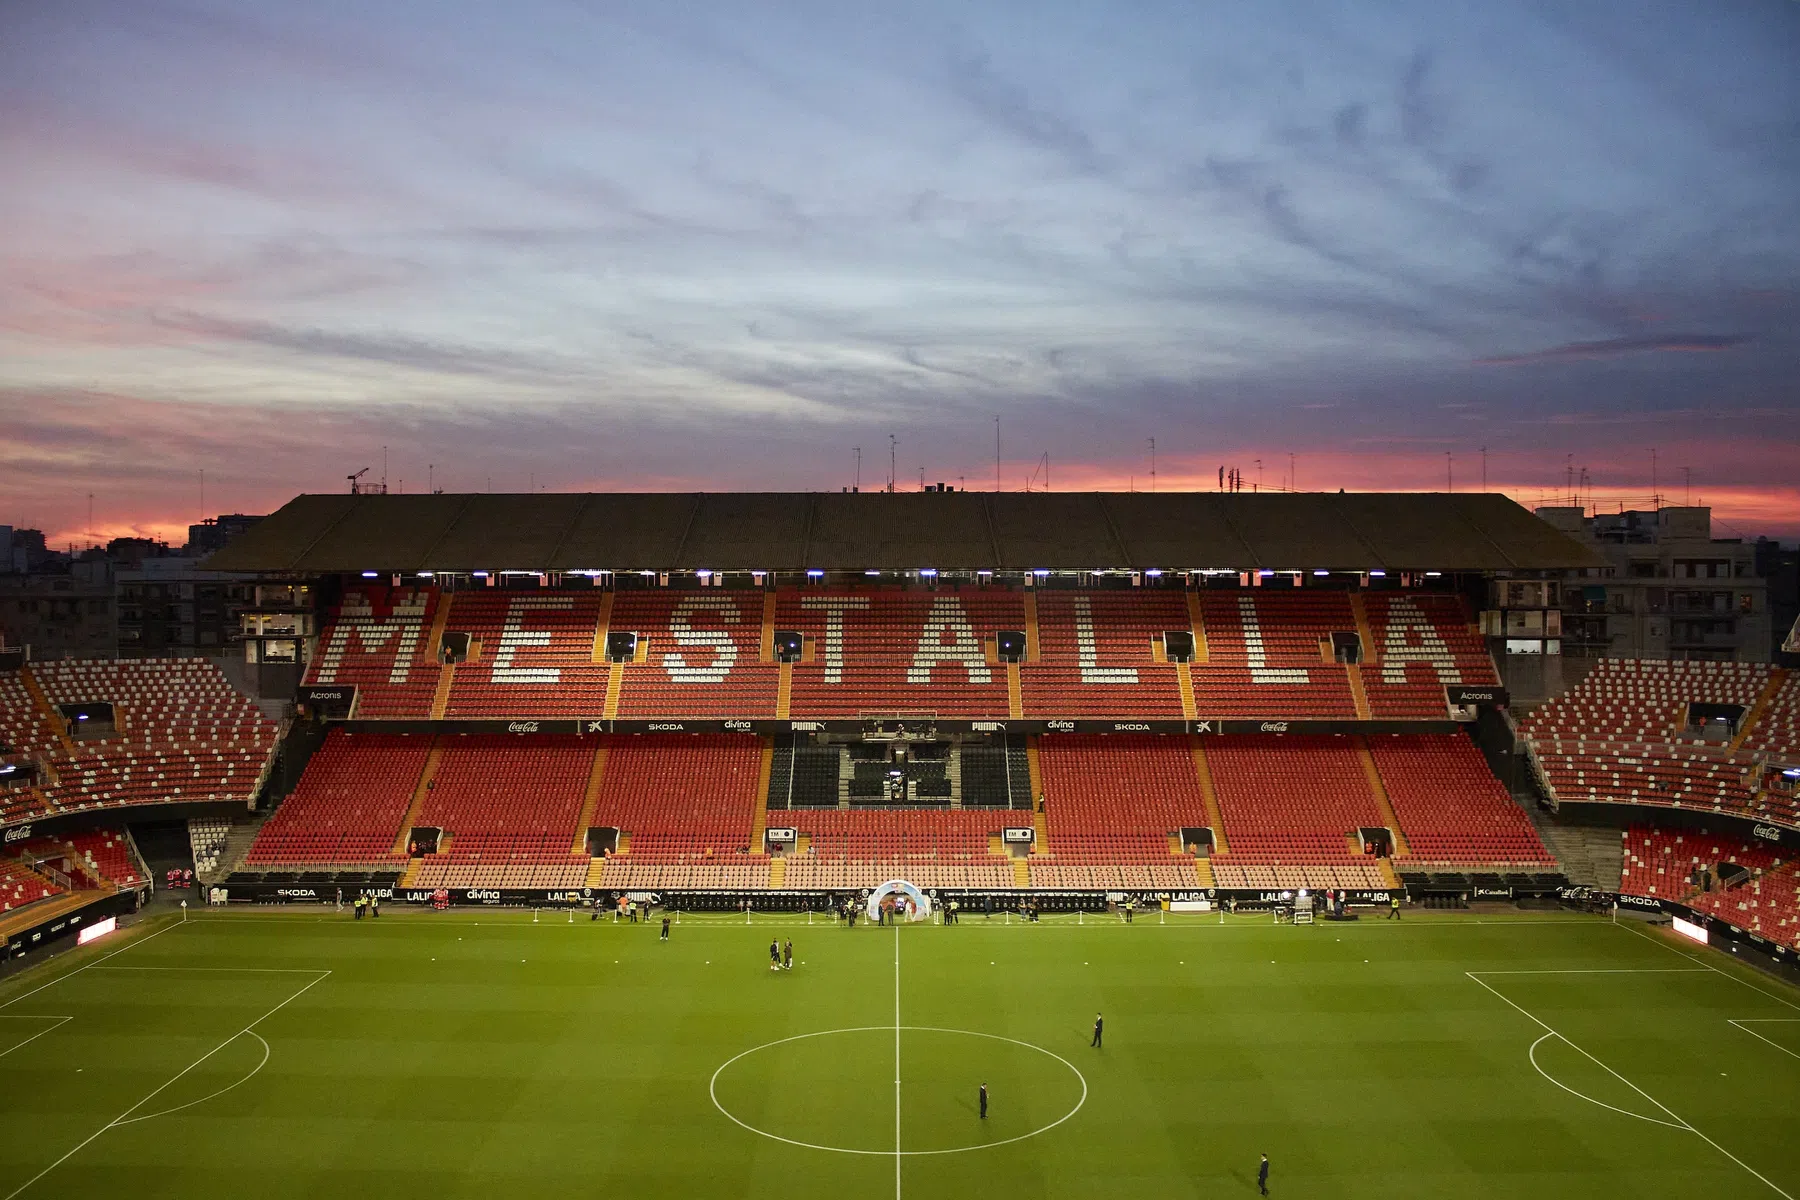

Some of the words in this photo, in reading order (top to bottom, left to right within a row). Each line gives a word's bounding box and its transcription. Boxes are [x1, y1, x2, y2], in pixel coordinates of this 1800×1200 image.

[317, 593, 1462, 683] MESTALLA
[310, 691, 342, 700] Acronis
[1460, 692, 1493, 701] Acronis
[648, 723, 684, 731] SKODA
[724, 720, 751, 729] divina
[791, 721, 817, 731] PUMA
[972, 721, 998, 731] PUMA
[1047, 720, 1075, 729] divina
[1114, 723, 1151, 731] SKODA
[466, 889, 500, 899] divina
[547, 892, 581, 901] LALIA
[1620, 895, 1662, 908] SKODA
